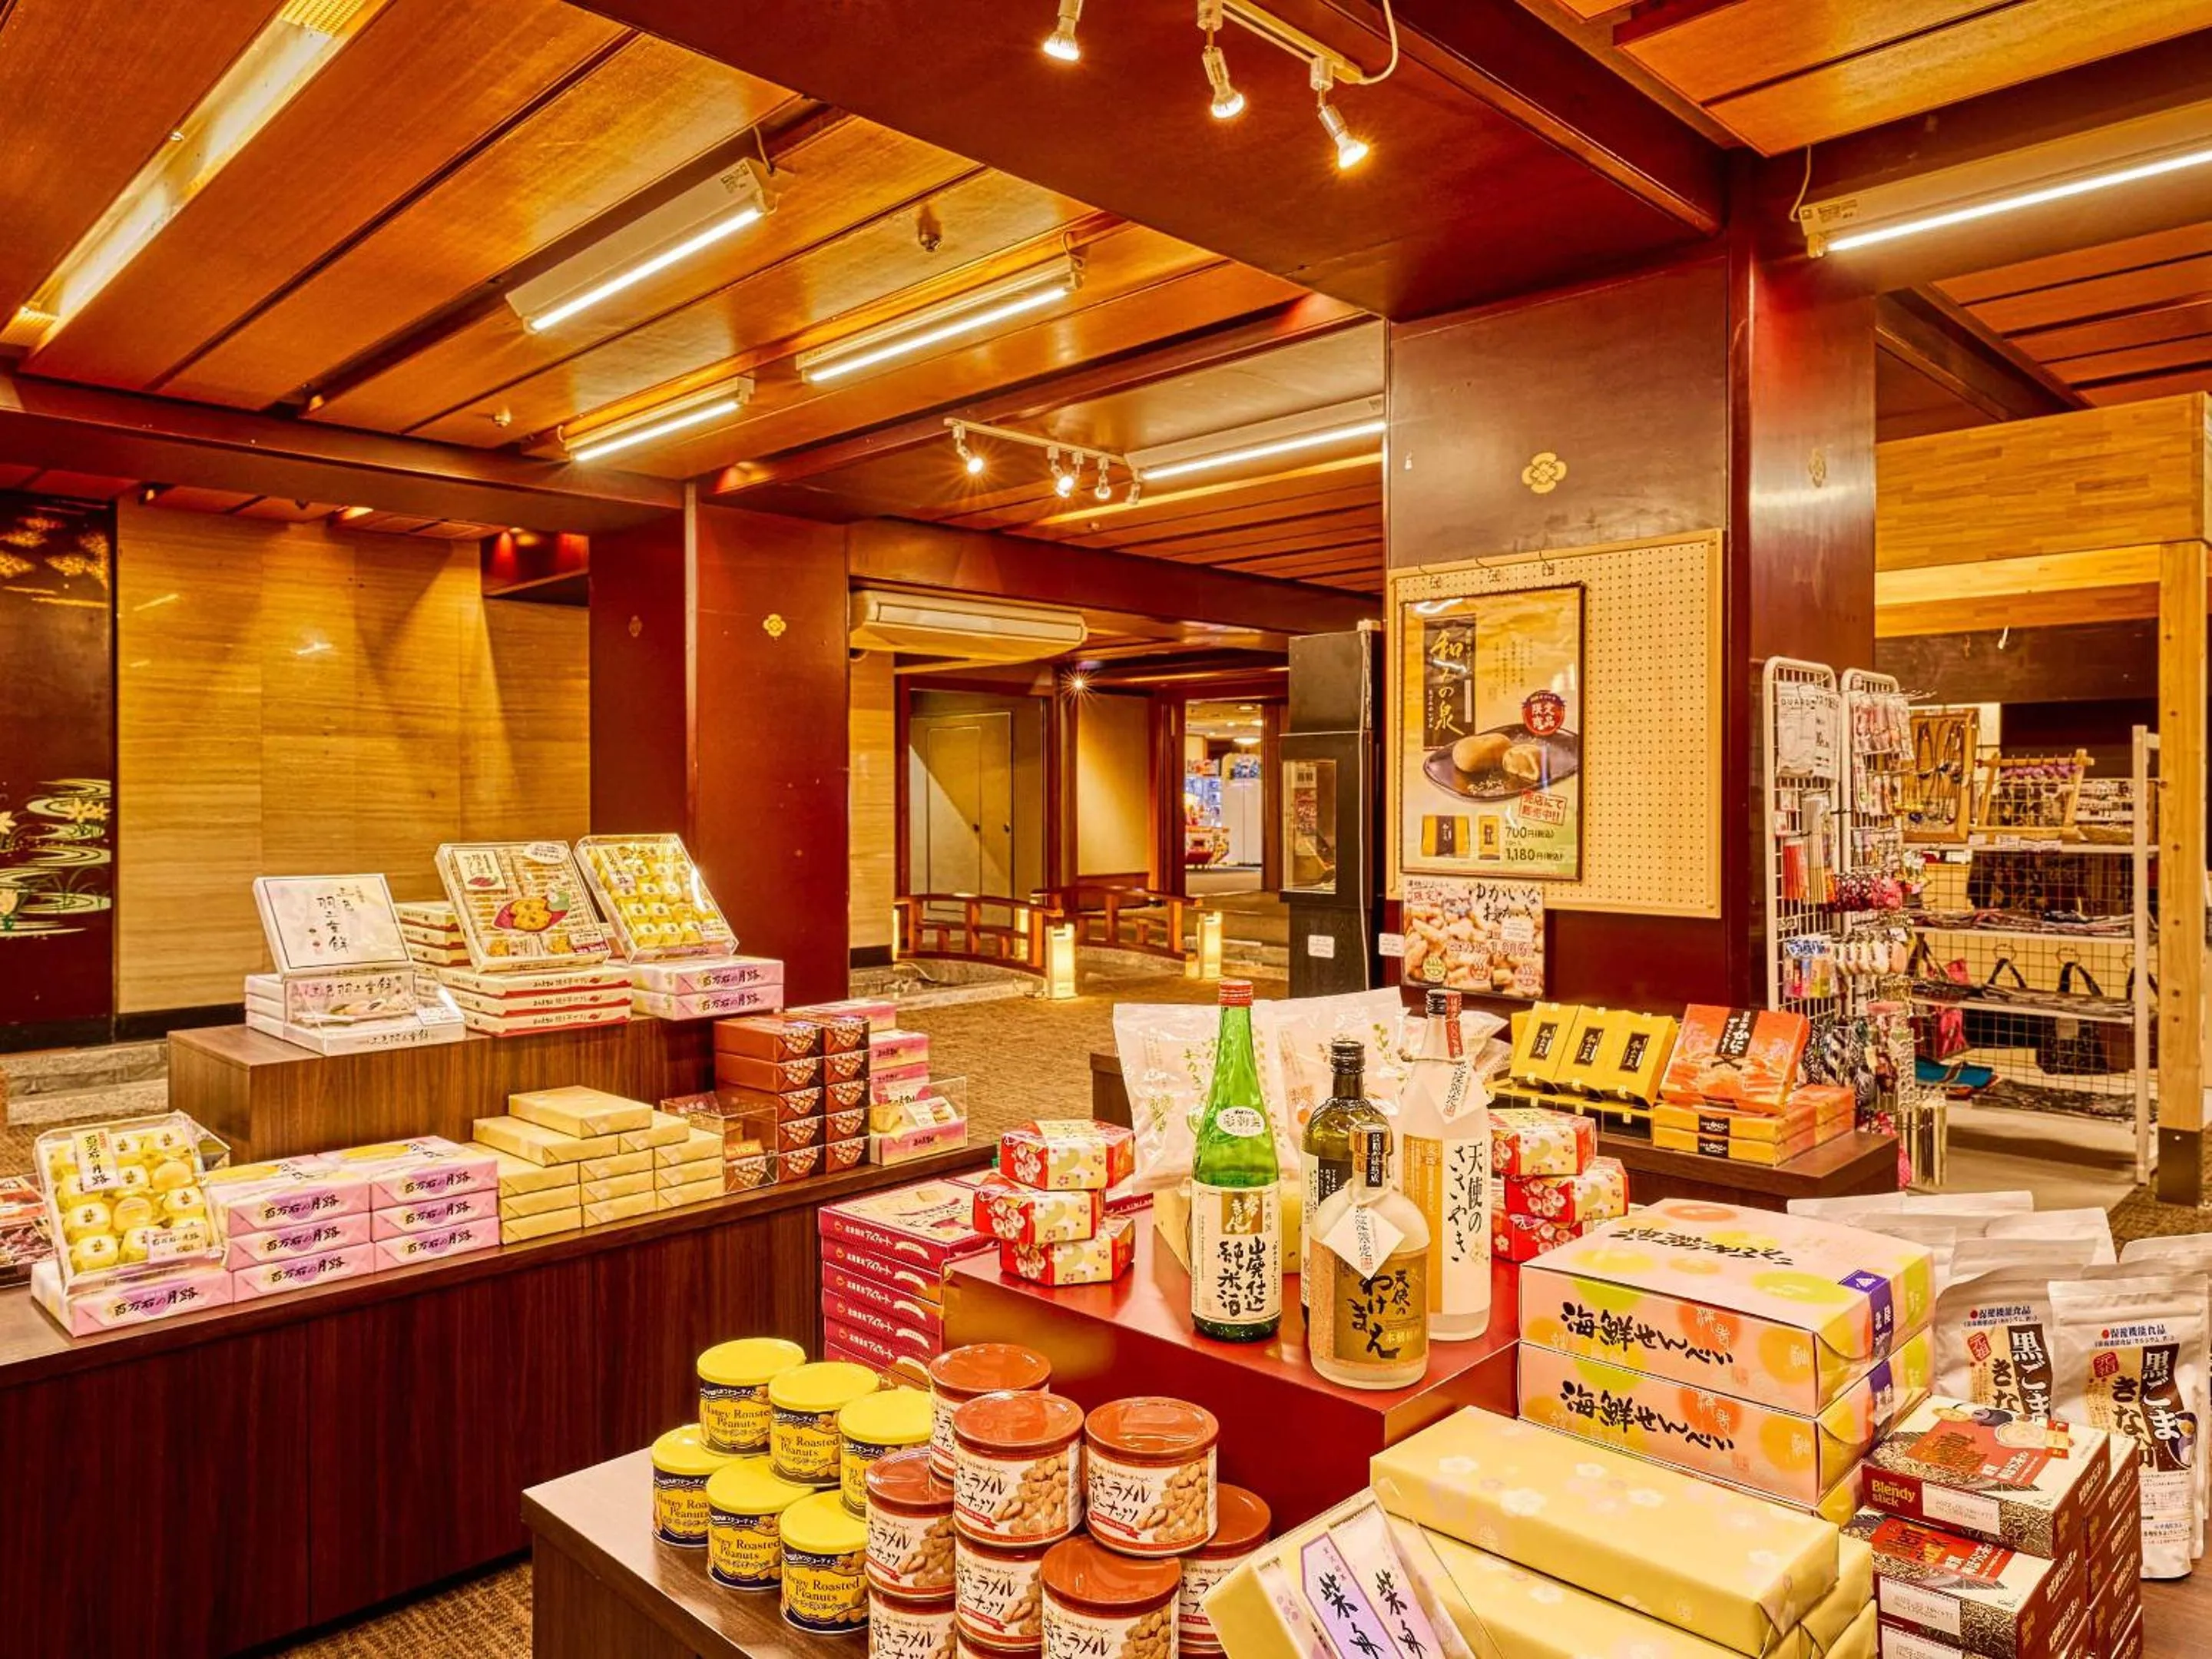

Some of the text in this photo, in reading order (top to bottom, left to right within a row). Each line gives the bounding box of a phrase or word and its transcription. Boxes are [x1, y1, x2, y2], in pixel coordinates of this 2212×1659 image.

[1447, 1145, 1468, 1263] ささやき
[1468, 1141, 1484, 1235] 天使の
[1216, 1240, 1245, 1317] 純米酒
[1560, 1302, 1734, 1366] 海鮮せんべい
[733, 1409, 770, 1419] Roaste
[1560, 1380, 1734, 1452] 海鮮せんべい
[2142, 1350, 2181, 1440] 黒ごま
[1871, 1479, 1917, 1502] Blendy
[1872, 1493, 1899, 1508] stick
[795, 1584, 837, 1601] Peanuts
[813, 1576, 860, 1591] Roasted
